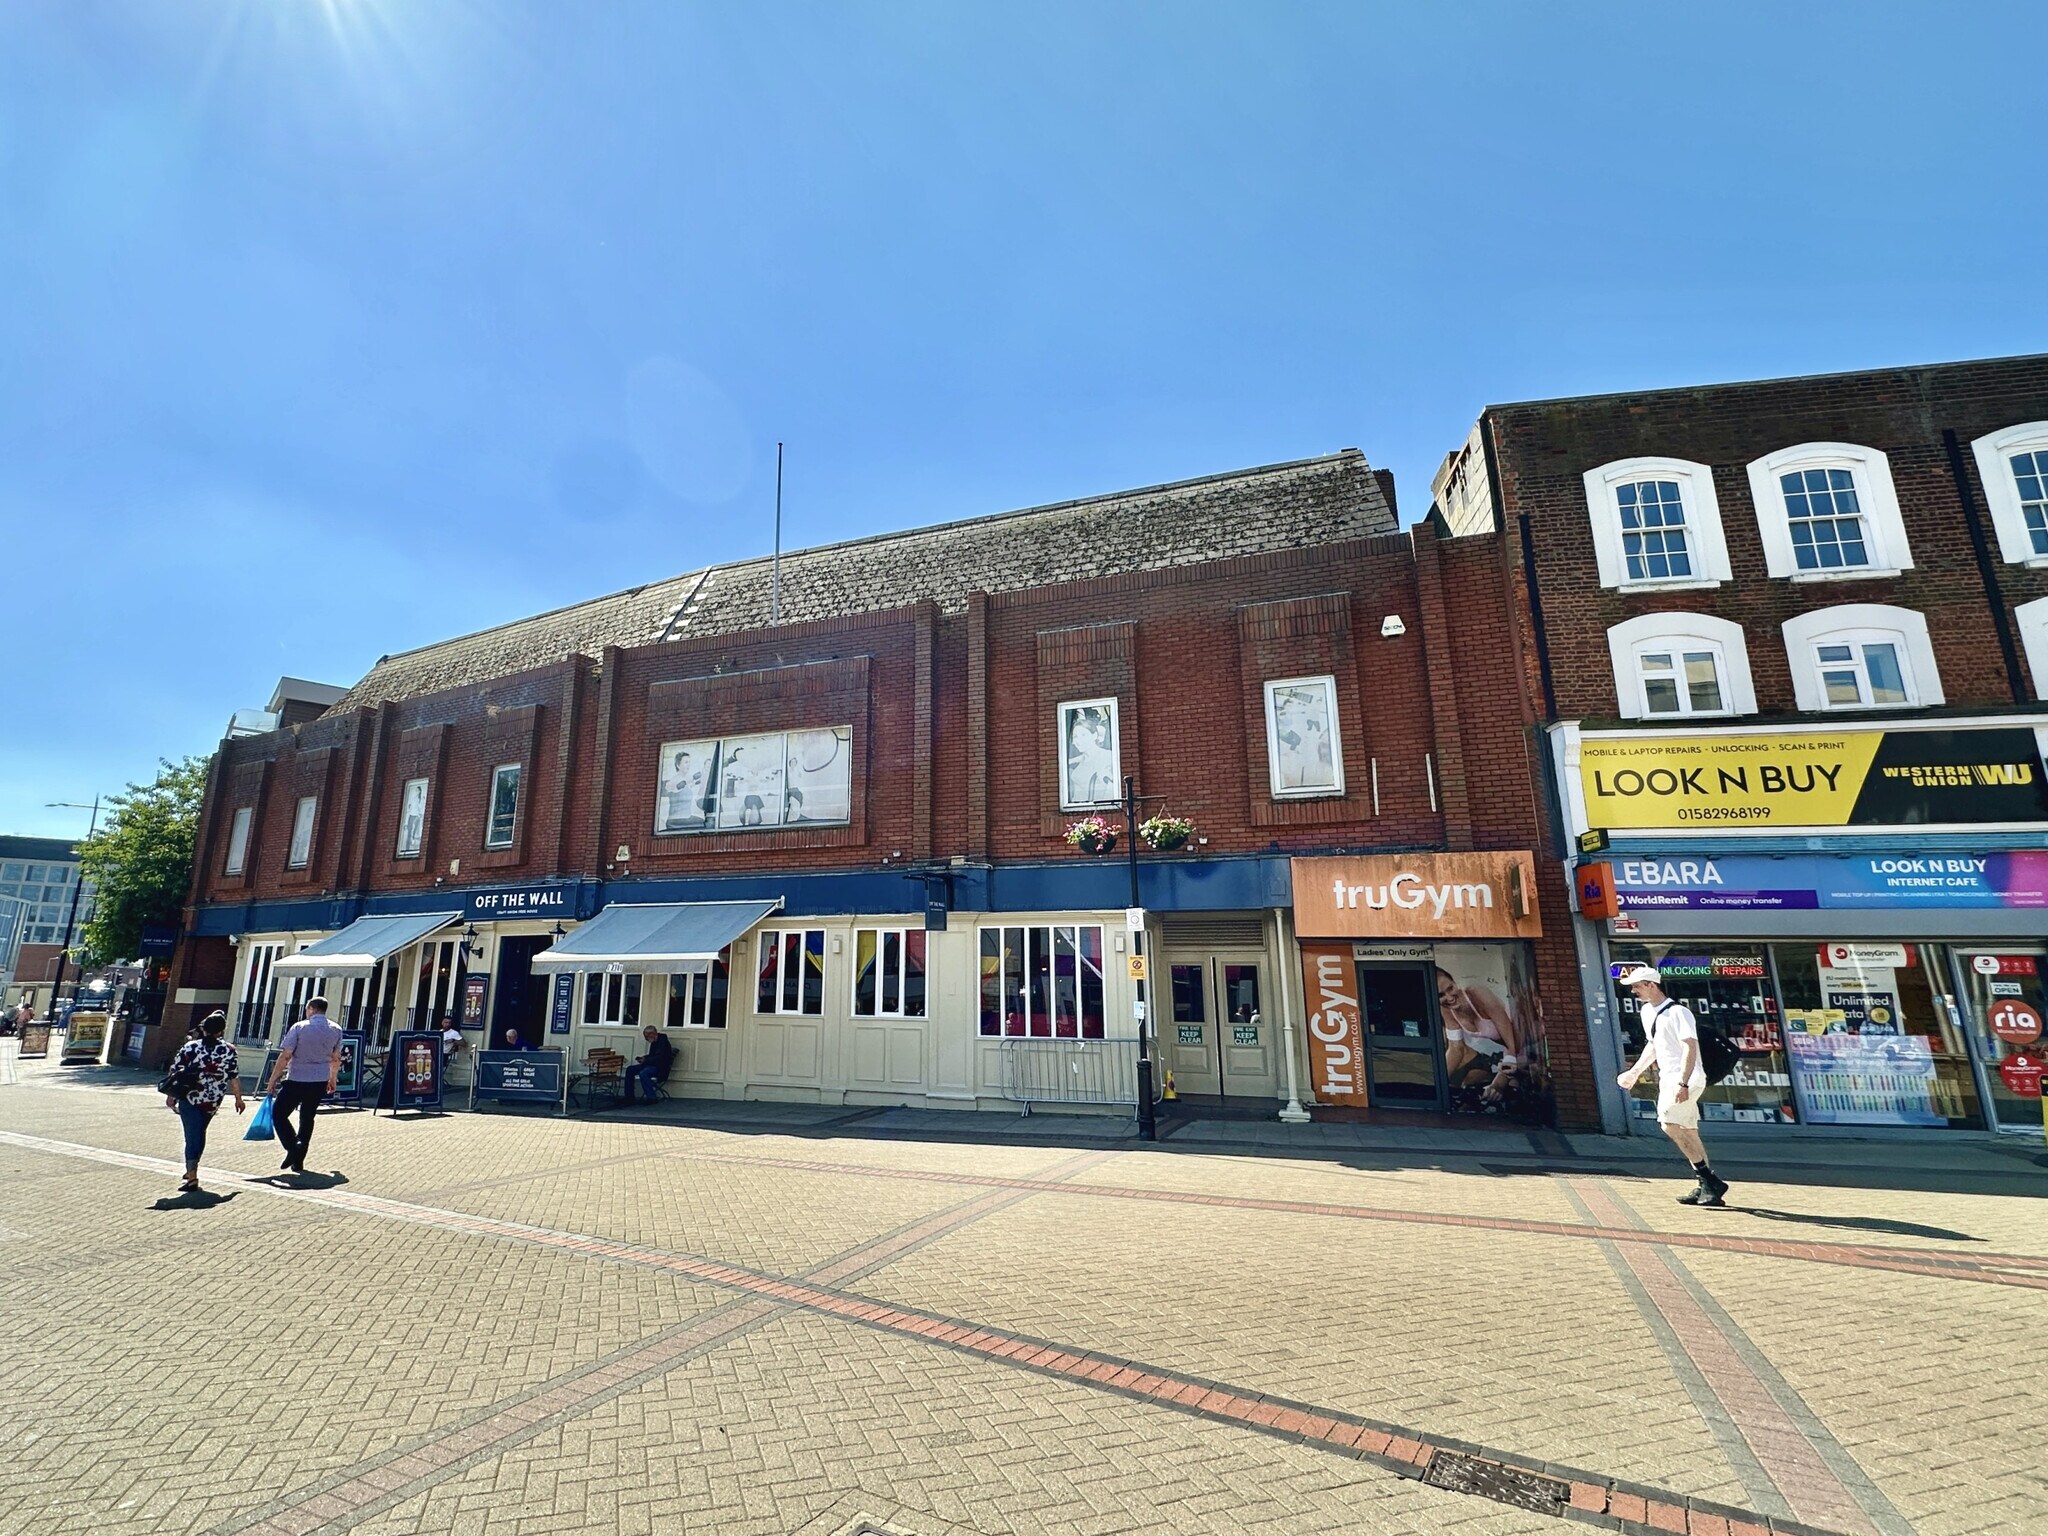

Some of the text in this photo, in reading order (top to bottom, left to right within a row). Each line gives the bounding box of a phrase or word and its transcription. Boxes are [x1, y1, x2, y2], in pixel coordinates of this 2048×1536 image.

[1584, 748, 1618, 756] MOBILE
[1629, 747, 1663, 755] LAPTOP
[1665, 746, 1702, 754] REPAIRS
[1711, 744, 1769, 752] UNLOCKING
[1779, 743, 1806, 751] SCAN
[1808, 742, 1815, 750] &
[1818, 742, 1845, 750] PRINT
[1882, 765, 1971, 777] WESTERN
[1979, 763, 2033, 785] WU
[1594, 764, 1843, 797] LOOK N BUY
[1912, 776, 1972, 787] UNION
[1677, 807, 1771, 819] 01582968199
[1870, 858, 1986, 874] LOOK N BUY
[1887, 877, 1979, 887] INTERNET CAFE
[1584, 879, 1601, 899] Ria
[475, 891, 564, 908] OFF THE WALL
[1333, 872, 1493, 920] truGym
[1626, 895, 1689, 905] WorldRemit
[1700, 897, 1783, 906] Online money transfer
[1388, 949, 1406, 957] Only
[1409, 949, 1429, 957] Gym
[1711, 957, 1763, 966] ACCESSORIES
[1656, 966, 1763, 975] UNLOCKING & REPAIRS
[1833, 995, 1890, 1006] Unlimited
[1844, 1009, 1864, 1019] ata
[1994, 1005, 2036, 1028] ria
[1310, 955, 1358, 1096] truGym
[1348, 1011, 1363, 1095] www.trugym.co.uk
